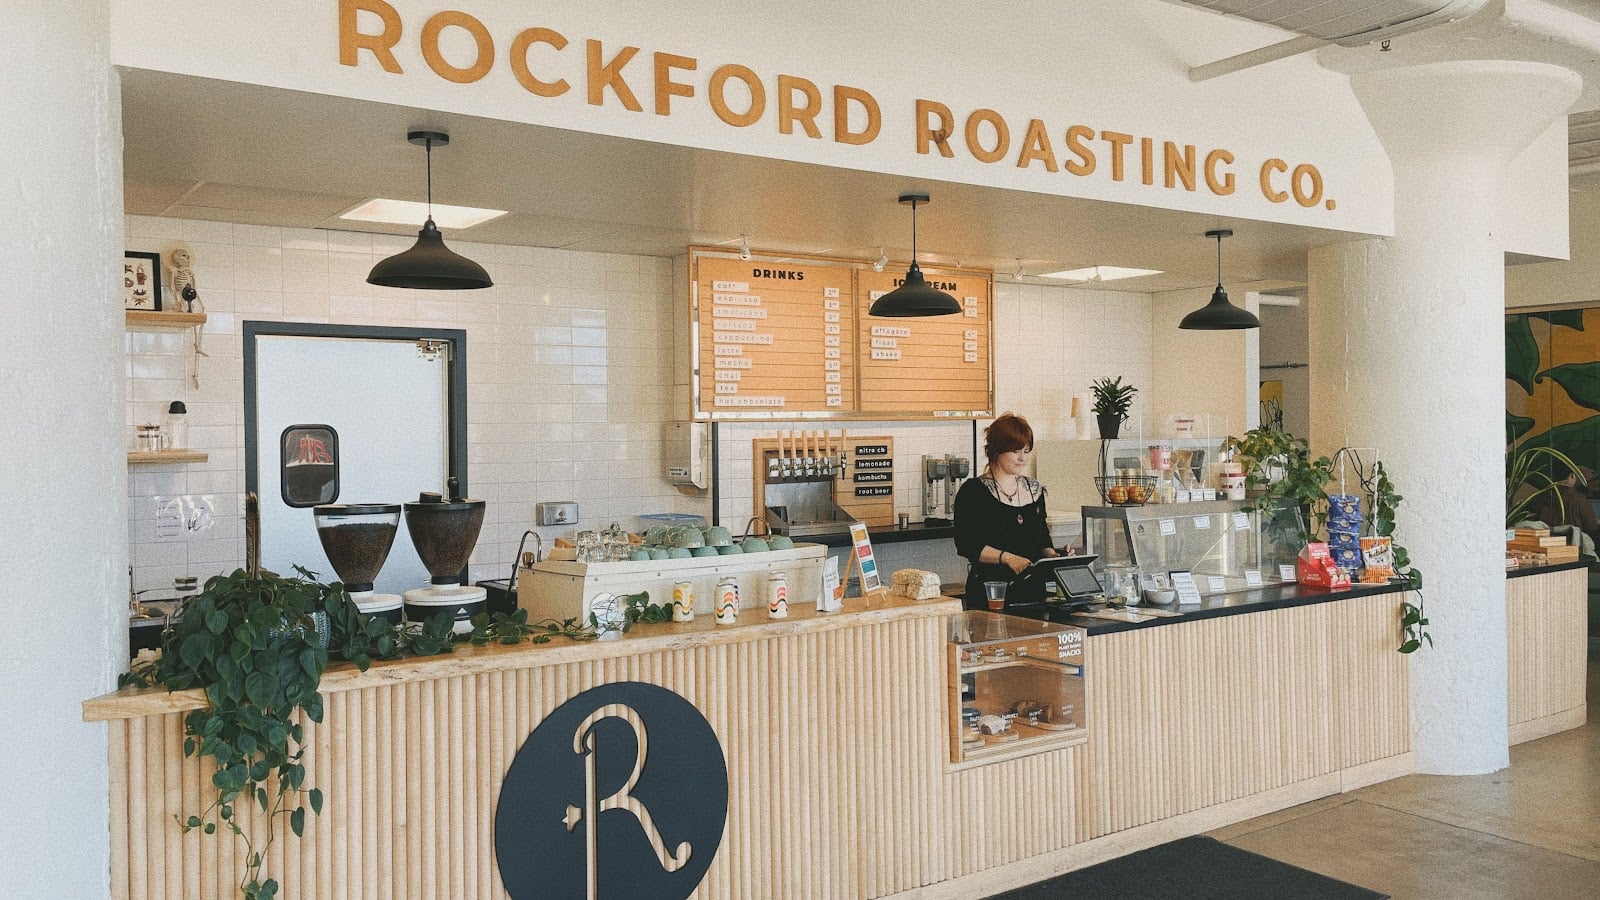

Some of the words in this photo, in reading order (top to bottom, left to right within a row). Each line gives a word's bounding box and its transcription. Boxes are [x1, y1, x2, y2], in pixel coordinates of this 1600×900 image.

[338, 0, 882, 146] ROCKFORD
[915, 98, 1235, 197] ROASTING
[1260, 157, 1336, 211] CO.
[752, 268, 805, 281] DRINKS
[1057, 631, 1082, 645] 100%
[1058, 648, 1082, 658] SNACKS
